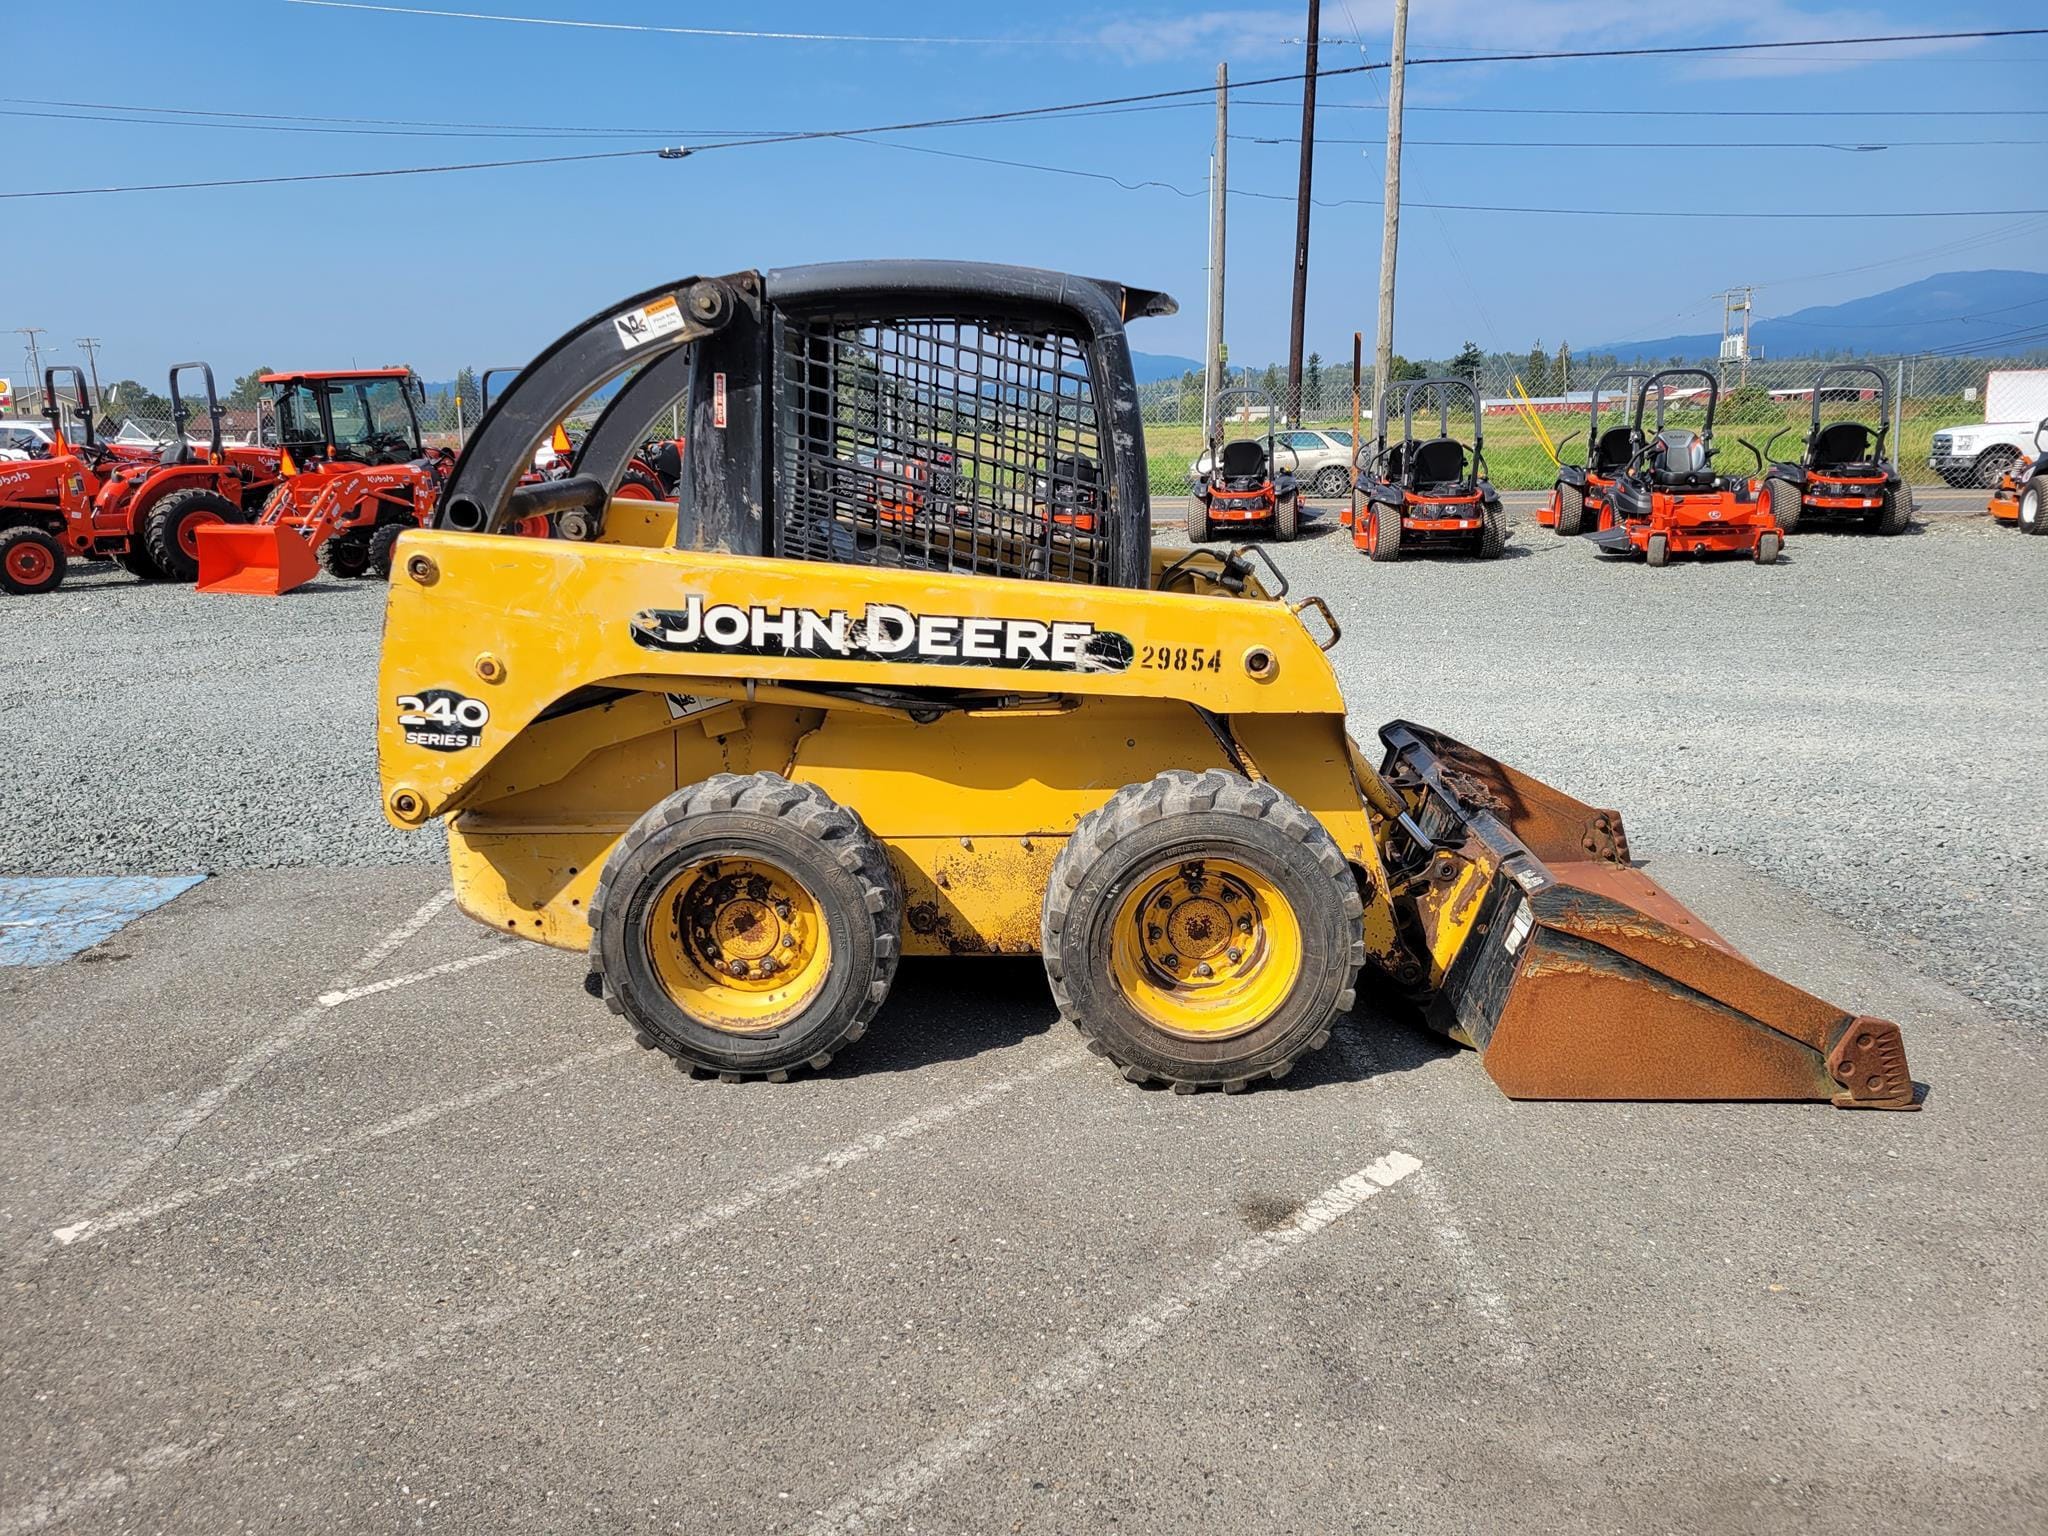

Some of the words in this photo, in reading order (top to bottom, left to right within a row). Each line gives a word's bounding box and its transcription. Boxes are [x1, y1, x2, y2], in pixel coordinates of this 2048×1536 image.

[0, 471, 30, 486] bota
[367, 475, 394, 483] Kubota
[665, 595, 851, 656] JOHN
[865, 603, 1094, 663] DEERE
[1140, 645, 1222, 673] 29854
[397, 696, 489, 728] 240
[406, 732, 468, 747] SERIES
